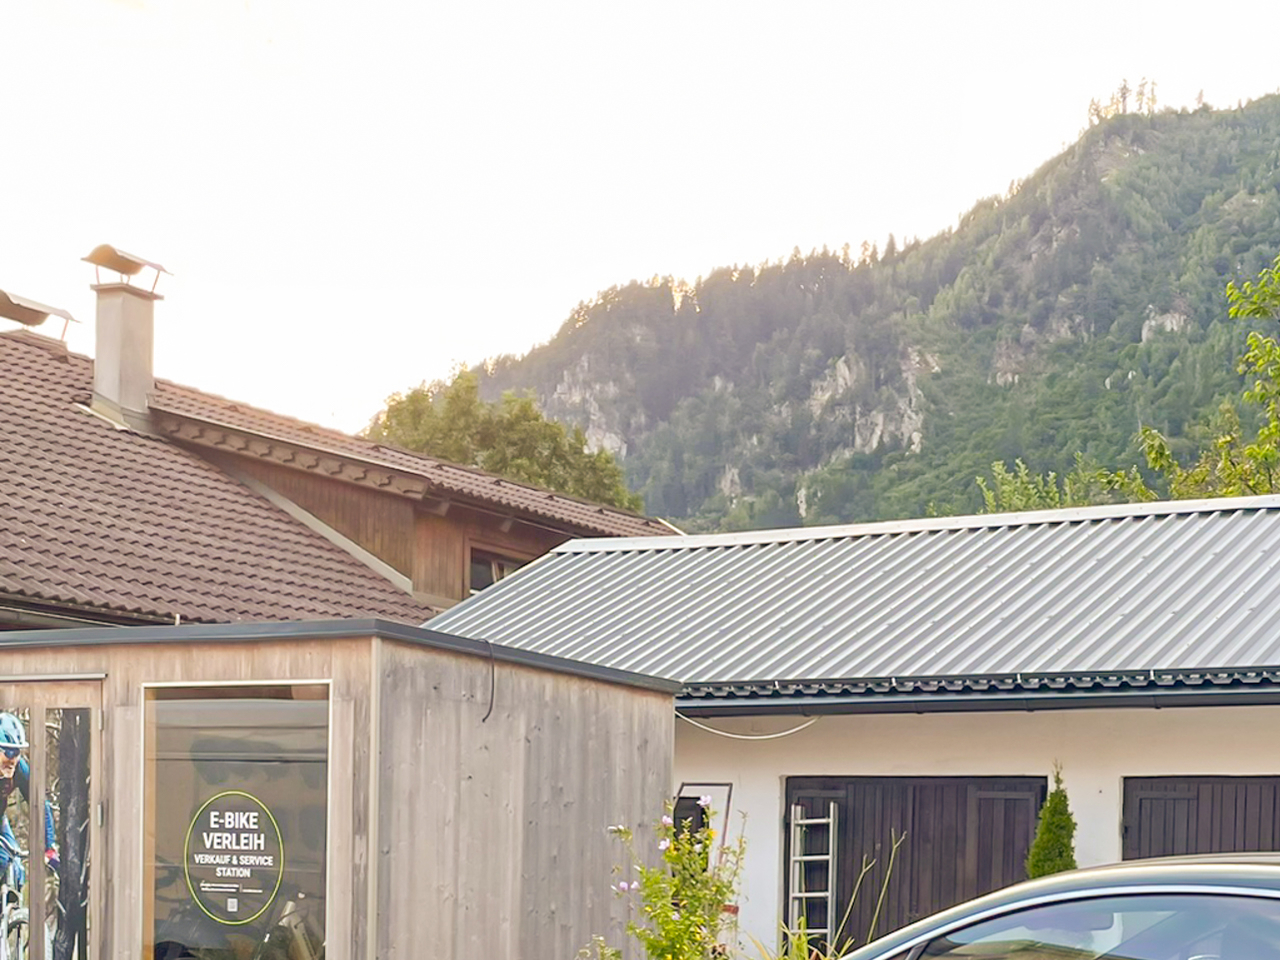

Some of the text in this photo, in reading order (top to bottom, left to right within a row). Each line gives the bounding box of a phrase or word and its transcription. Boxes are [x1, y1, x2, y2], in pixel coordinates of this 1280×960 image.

[209, 811, 259, 829] E-BIKE
[202, 832, 265, 850] VERLEIH
[194, 854, 273, 866] VERKAUF & SERVICE
[215, 867, 251, 878] STATION
